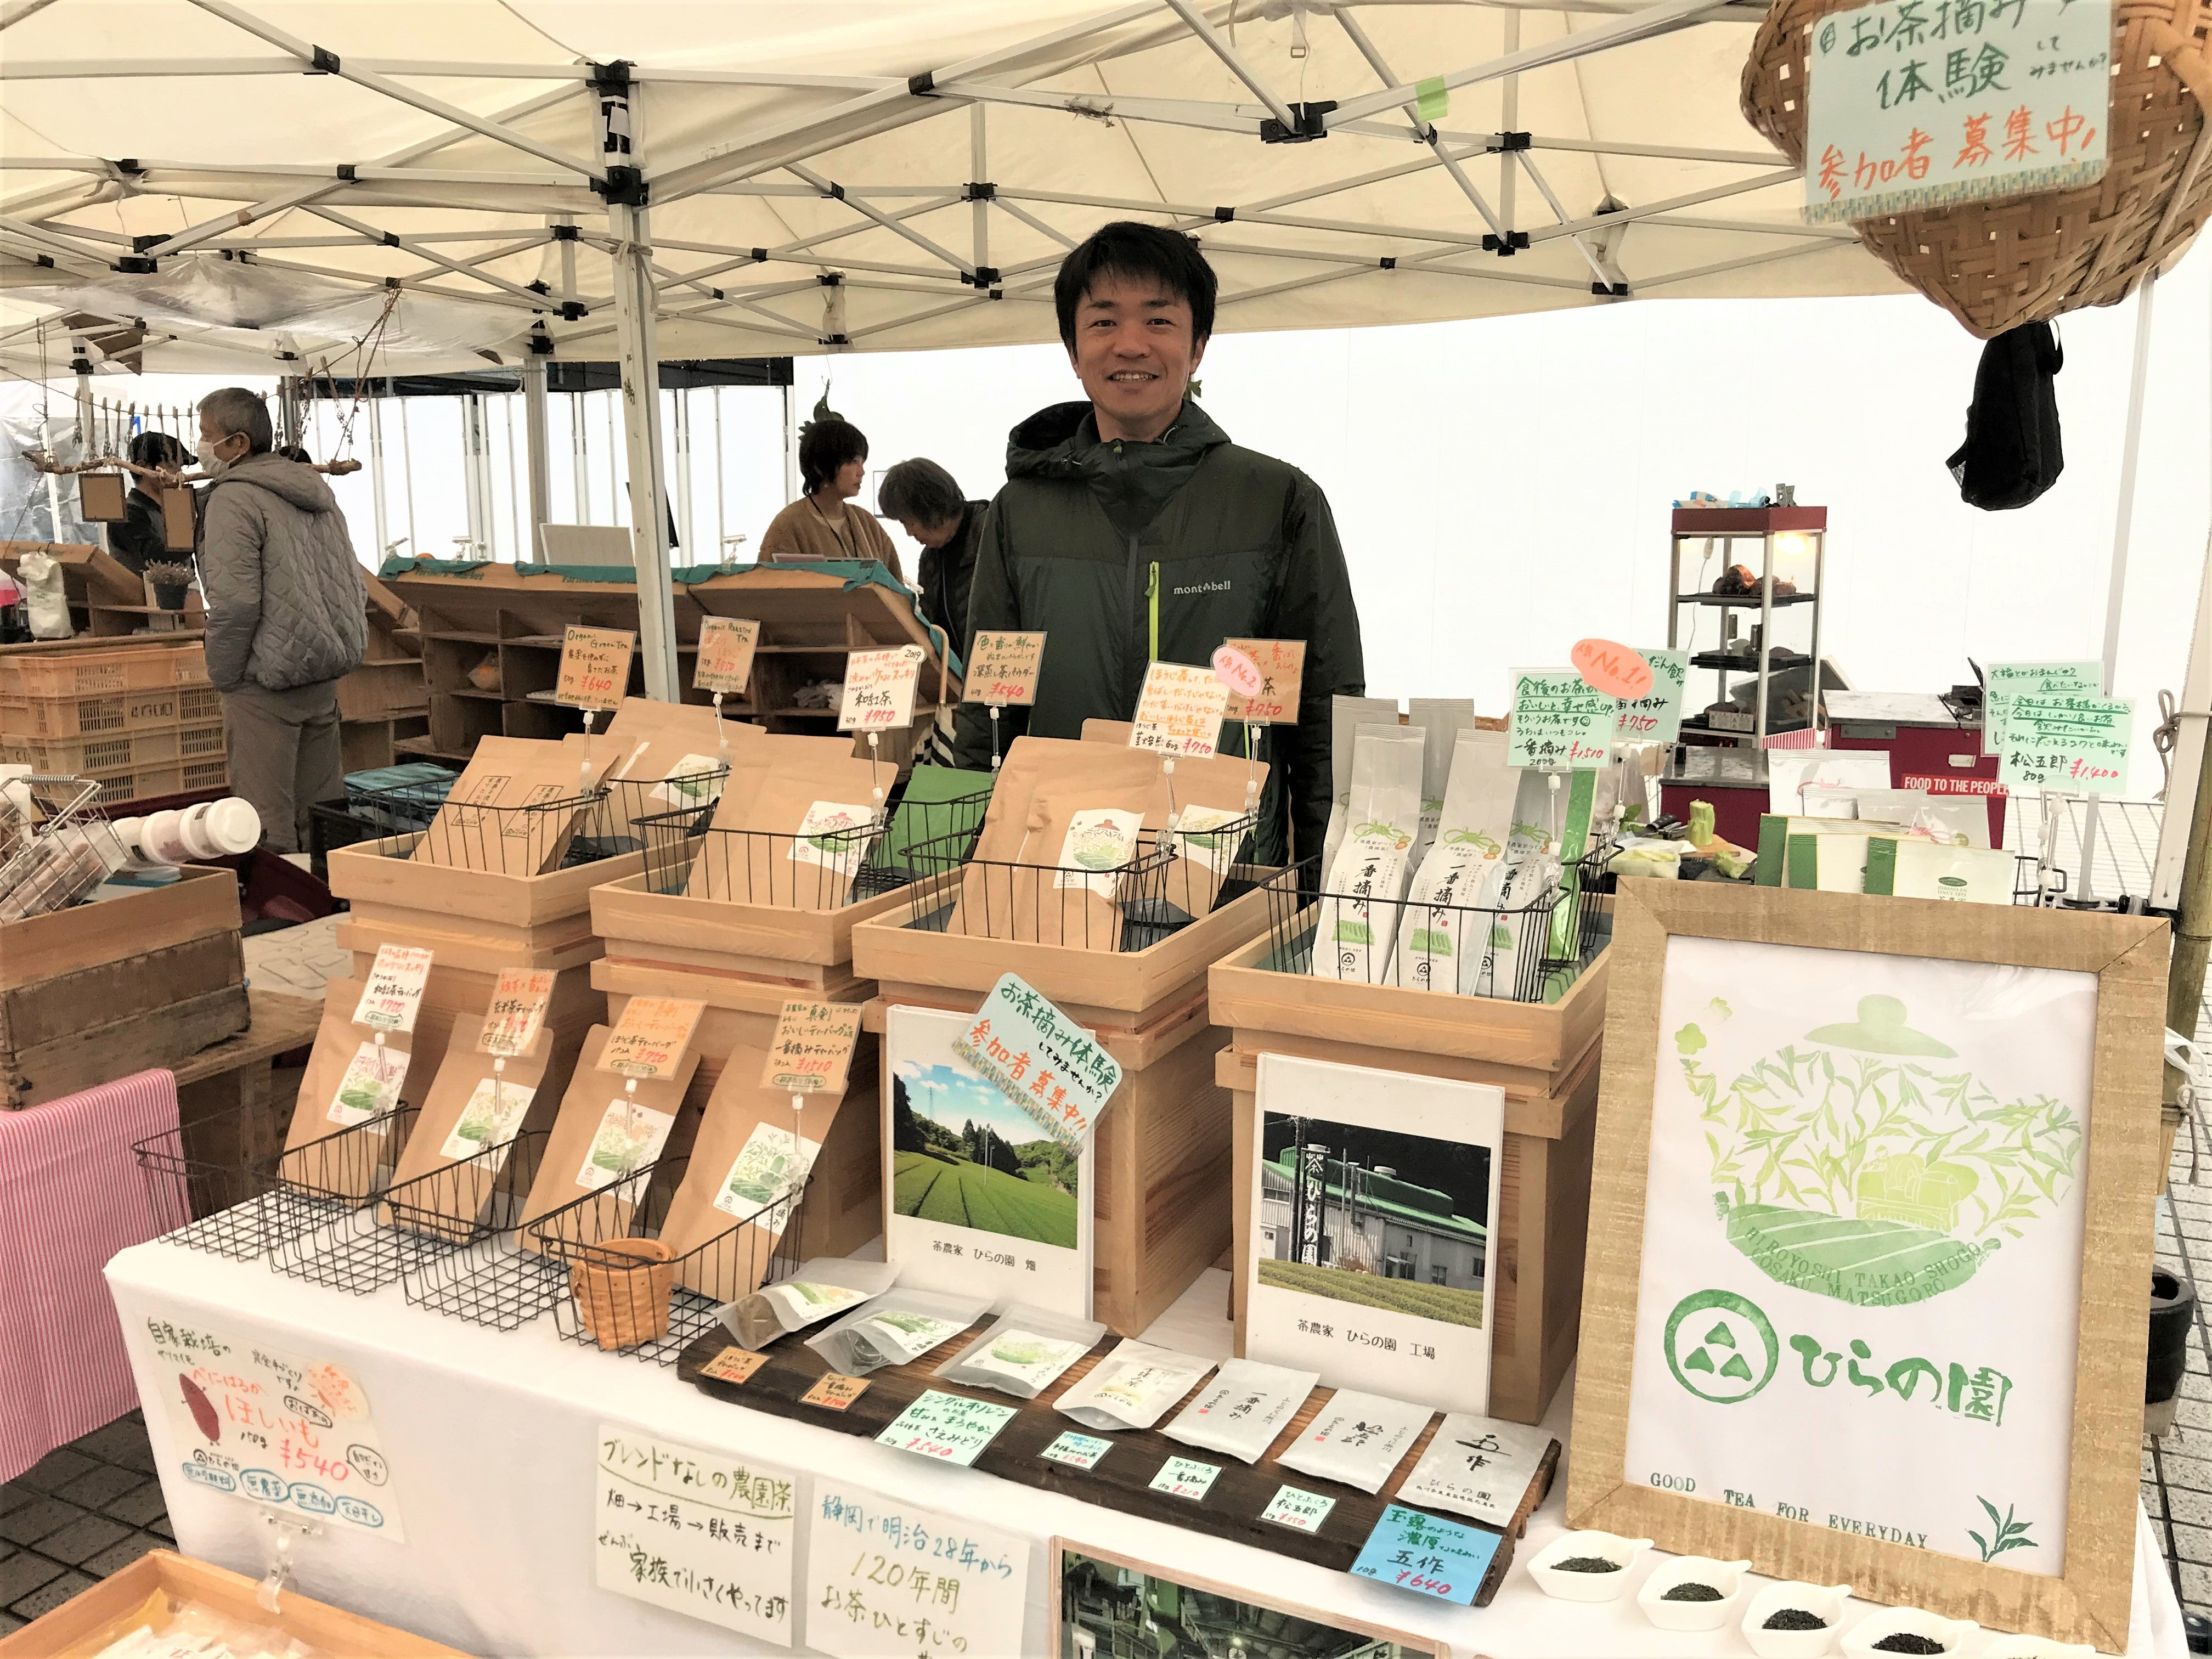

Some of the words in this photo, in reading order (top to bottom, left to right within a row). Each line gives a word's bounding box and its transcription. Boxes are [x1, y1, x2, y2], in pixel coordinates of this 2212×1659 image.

[1846, 0, 2075, 56] お茶摘み
[1876, 42, 2011, 110] 体験
[1818, 128, 1933, 200] 参加者
[590, 639, 614, 649] Green
[905, 649, 922, 661] 2019
[581, 675, 612, 691] ¥640
[1639, 653, 1684, 687] だん飲み
[855, 690, 891, 707] 和紅茶
[989, 682, 1024, 697] ¥540
[1262, 676, 1276, 696] 茶
[1246, 698, 1282, 716] ¥750
[1618, 714, 1658, 731] ¥750
[1183, 738, 1212, 754] ¥750
[1515, 738, 1567, 756] 一番摘み
[2010, 751, 2068, 773] 松五郎
[1904, 777, 1932, 790] FOOD
[1934, 778, 1947, 791] TO
[1949, 779, 1969, 792] THE
[1970, 781, 2009, 795] PEOPLE
[2023, 770, 2046, 783] 80g
[1352, 857, 1380, 915] 一番摘み
[1432, 865, 1465, 923] 一番摘み
[805, 1004, 832, 1022] 真剣
[969, 1018, 1031, 1080] 参加者
[1001, 982, 1118, 1094] お茶摘み体験
[635, 1048, 668, 1063] ¥750
[1039, 1041, 1102, 1103] してみませんか?
[933, 1241, 963, 1257] 茶農家
[973, 1248, 1015, 1267] ひらの園
[1025, 1260, 1036, 1271] 畑
[1745, 1226, 1841, 1284] HIROYOSHI
[1855, 1271, 1916, 1288] TAKAO
[1927, 1241, 1982, 1278] SHOGO
[1751, 1248, 1812, 1290] GOSAKU
[1828, 1278, 1947, 1308] MATSUGORO
[1297, 1319, 1334, 1338] 茶農家
[1347, 1329, 1397, 1352] ひらの園
[1409, 1343, 1436, 1360] 工場
[1789, 1334, 2013, 1427] ひらの園
[1229, 1391, 1268, 1420] 一番摘み
[225, 1395, 319, 1449] ほしいも
[905, 1437, 953, 1457] ¥540
[926, 1426, 983, 1449] さえみどり
[280, 1438, 349, 1481] ¥540
[603, 1439, 793, 1513] ブレンドなしの農園茶
[1430, 1479, 1492, 1501] ひらの園
[1276, 1498, 1317, 1516] 松五郎
[1278, 1513, 1306, 1525] ¥350
[1650, 1472, 1696, 1493] GOOD
[1724, 1489, 1755, 1508] TEA
[1776, 1502, 1809, 1523] FOR
[1828, 1514, 1929, 1549] EVERYDAY
[821, 1494, 1013, 1579] 静岡で明治28年から
[1387, 1550, 1444, 1574] 五作
[850, 1552, 961, 1614] 120年間
[1396, 1569, 1452, 1594] ¥640
[820, 1584, 968, 1652] お茶ひとすじの
